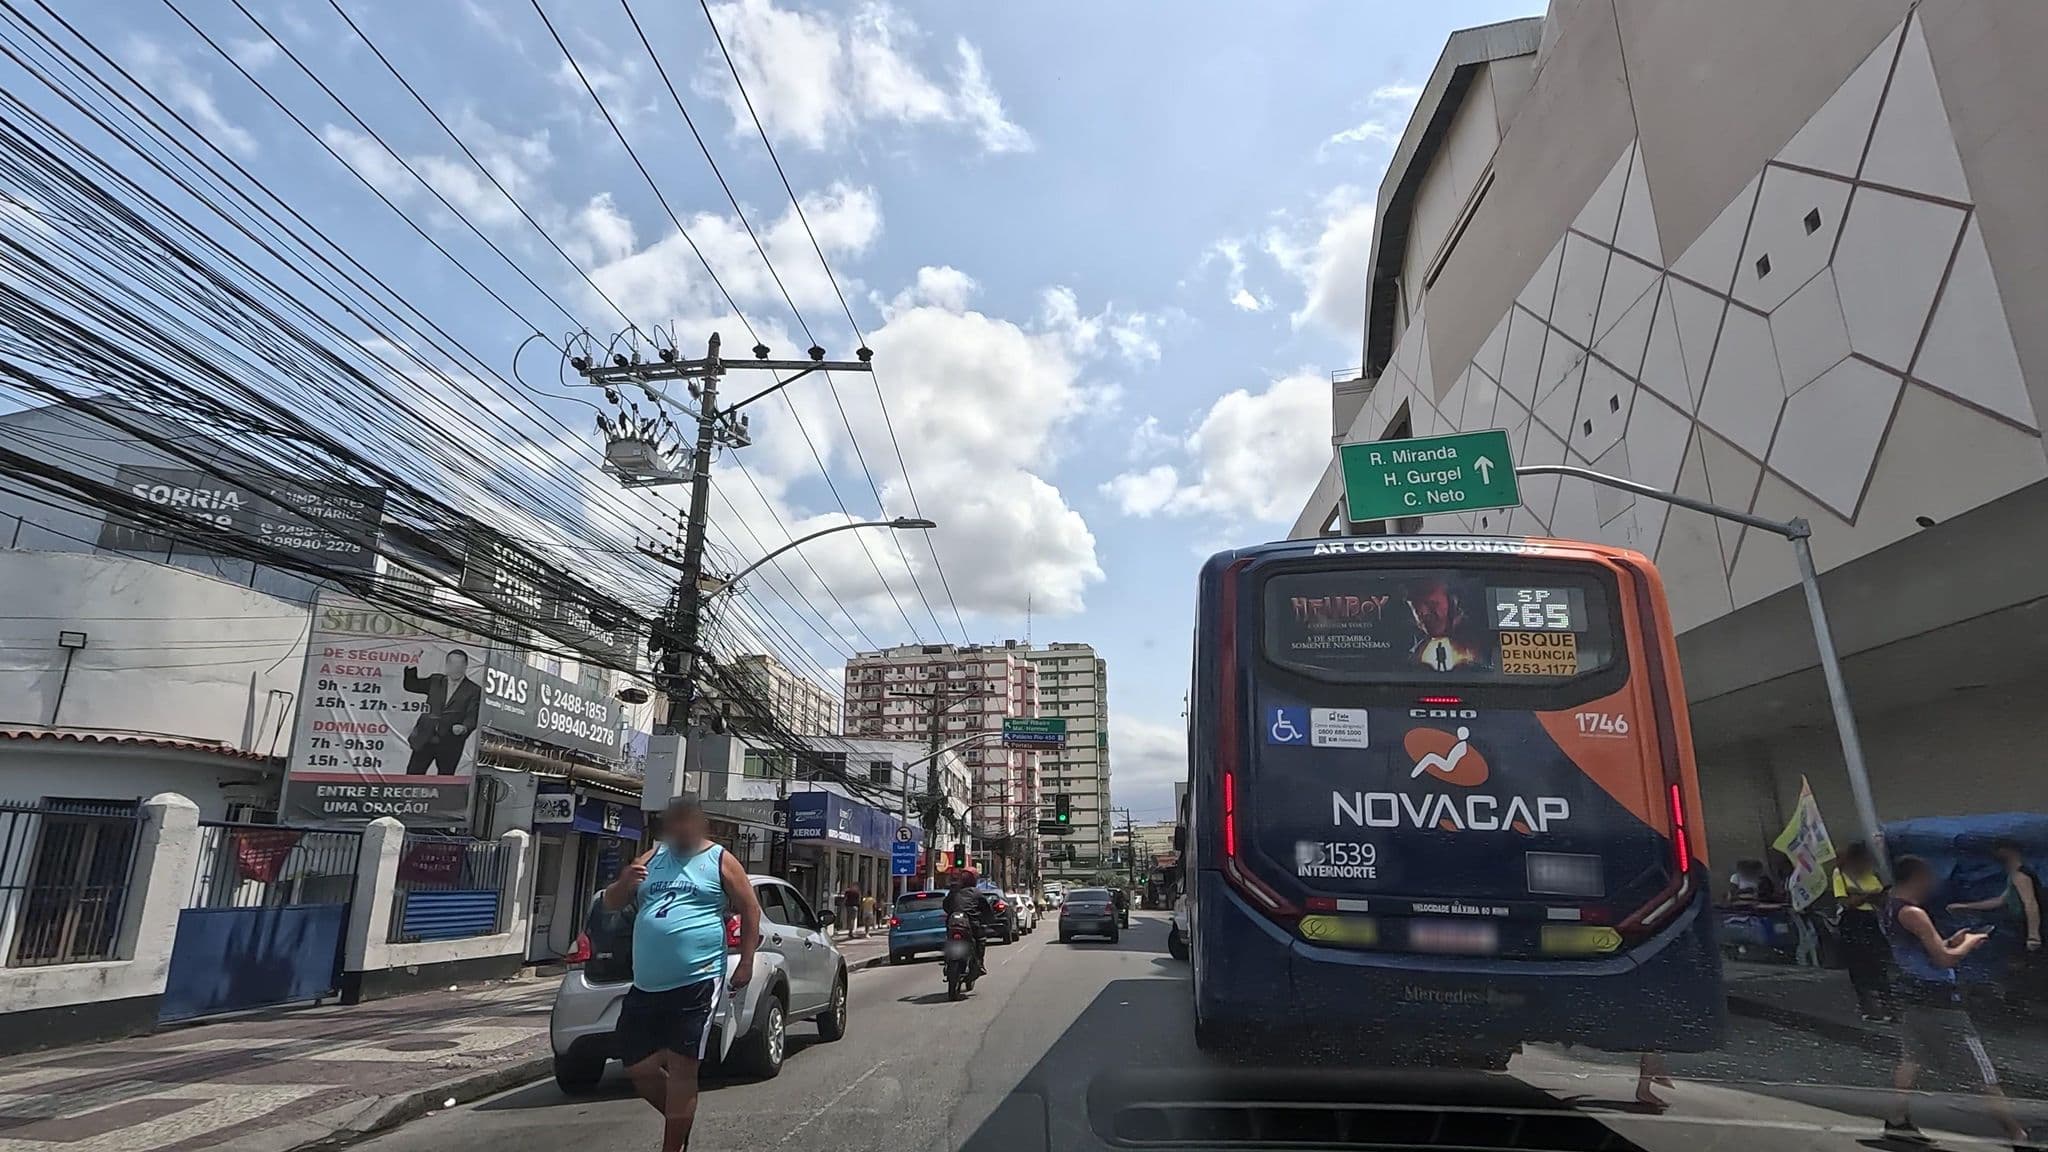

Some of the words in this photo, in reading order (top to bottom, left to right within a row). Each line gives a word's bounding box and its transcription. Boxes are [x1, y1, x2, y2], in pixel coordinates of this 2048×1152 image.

[1370, 452, 1387, 466] R.
[1393, 446, 1458, 464] Miranda
[1384, 473, 1402, 487] H.
[1407, 466, 1462, 485] Gurgel
[132, 484, 248, 511] SORRIA
[1404, 492, 1422, 506] C.
[1427, 489, 1466, 505] Neto
[1313, 542, 1347, 556] AR
[1517, 590, 1551, 603] SP
[1497, 604, 1570, 629] 265
[1501, 632, 1573, 647] DISQUE
[324, 647, 346, 658] DE
[348, 649, 419, 664] SEGUNDA
[1502, 647, 1576, 660] DENÚNCIA
[320, 664, 331, 675] A
[335, 664, 382, 677] SEXTA
[1504, 663, 1577, 674] 2253-1177
[317, 679, 338, 691] 9h
[352, 682, 381, 693] 12h
[315, 697, 346, 709] 15h
[359, 699, 388, 711] 17h
[401, 701, 430, 713] 19h
[554, 689, 607, 722] 2488-1853
[313, 721, 389, 734] DOMINGO
[551, 712, 615, 746] 98940-2278
[1575, 712, 1629, 734] 1746
[311, 738, 330, 749] 7h
[344, 739, 385, 751] 9h30
[308, 755, 338, 767] 15h
[352, 756, 382, 768] 18h
[317, 786, 366, 798] ENTRE
[370, 786, 380, 798] E
[383, 787, 439, 799] RECEBA
[324, 802, 358, 813] UMA
[363, 801, 429, 815] ORAÇÃO!
[1332, 791, 1570, 833] NOVACAP
[793, 828, 821, 837] XEROX
[1297, 865, 1377, 879] INTERNORTE
[655, 891, 677, 918] 2
[1412, 903, 1450, 914] VELOCIDADE
